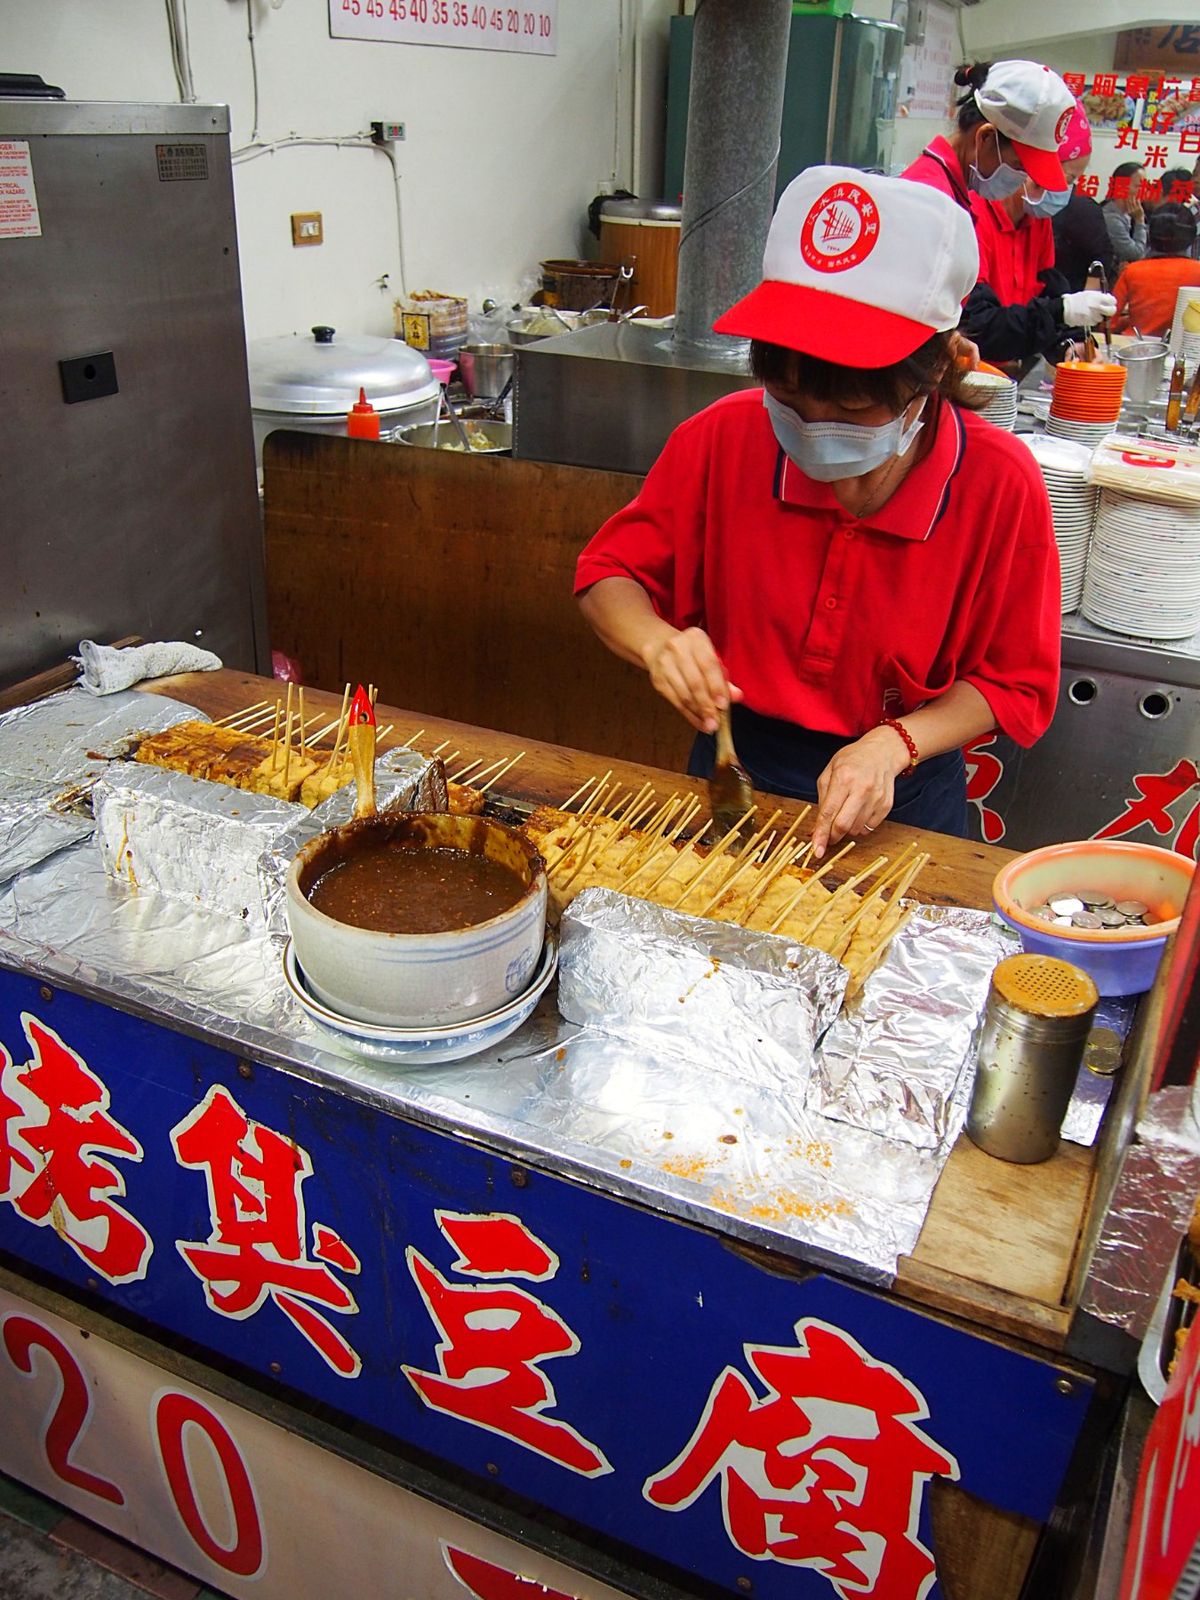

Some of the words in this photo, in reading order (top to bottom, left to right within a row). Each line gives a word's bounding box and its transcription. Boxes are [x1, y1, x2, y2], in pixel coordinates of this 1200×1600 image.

[366, 0, 383, 18] 45
[389, 0, 406, 20] 45
[410, 0, 427, 23] 40
[432, 0, 449, 24] 35
[453, 1, 468, 26] 35
[472, 5, 486, 30] 40
[490, 10, 503, 31] 45
[507, 9, 519, 33] 20
[524, 13, 535, 34] 20
[539, 15, 551, 37] 10
[0, 1011, 961, 1600] 烤臭豆腐
[2, 1309, 270, 1583] 20
